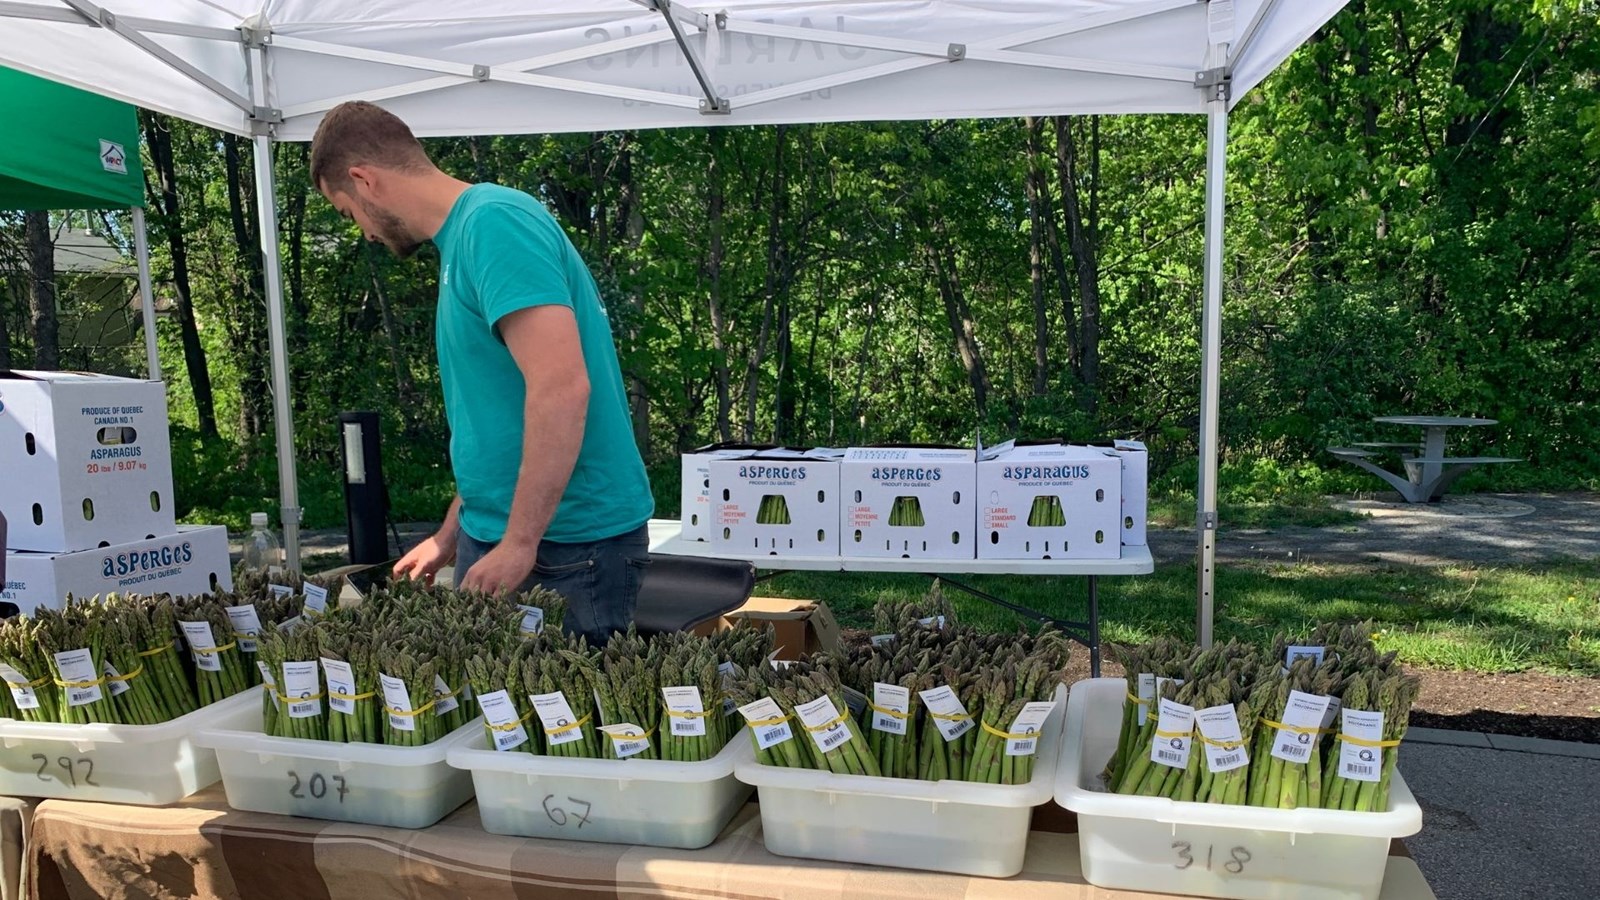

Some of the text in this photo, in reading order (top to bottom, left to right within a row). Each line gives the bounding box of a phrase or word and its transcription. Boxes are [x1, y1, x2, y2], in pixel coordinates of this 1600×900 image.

[81, 407, 111, 415] PRODUCE
[94, 417, 119, 425] CANADA
[90, 446, 142, 460] ASPARAGUS
[86, 463, 99, 473] 20
[118, 460, 137, 471] 9.07
[138, 462, 147, 470] kg
[5, 579, 26, 590] UÉBEC
[118, 575, 146, 587] PRODUIT
[147, 573, 157, 581] DU
[31, 753, 100, 788] 292
[287, 770, 350, 804] 207
[541, 794, 592, 829] 67
[1171, 840, 1252, 874] 318
